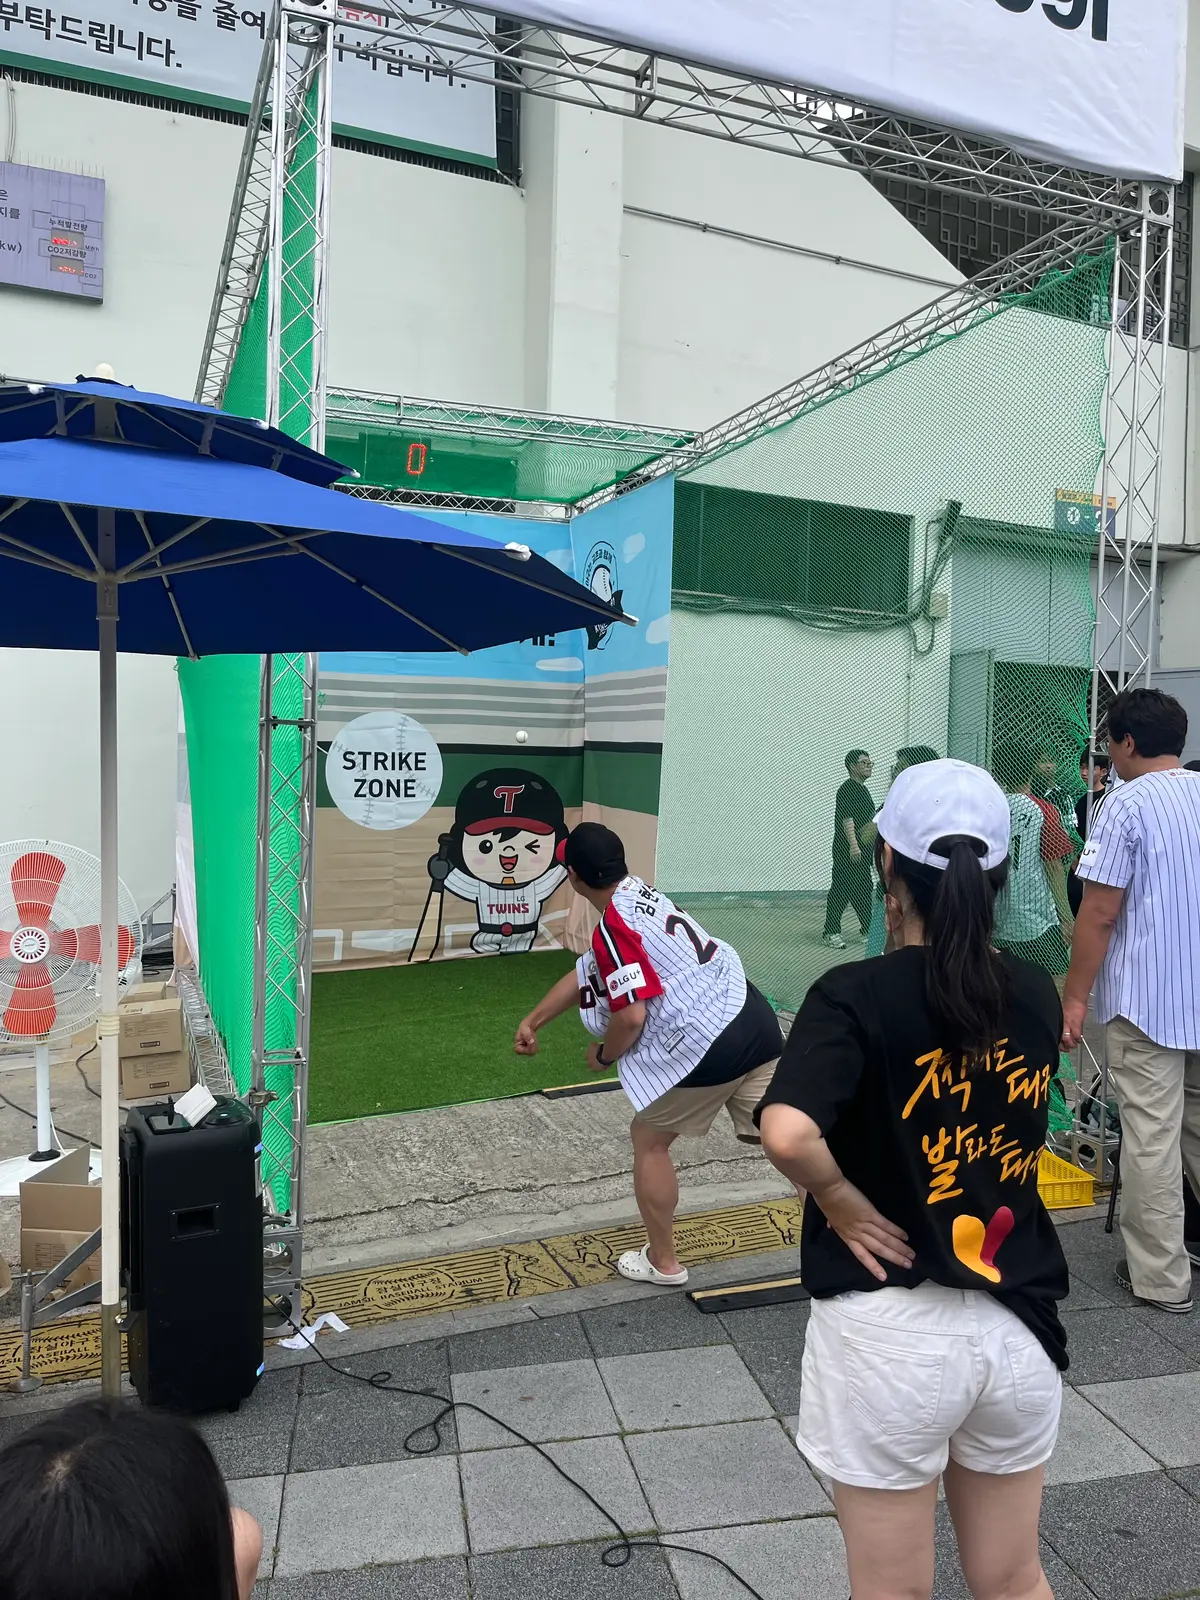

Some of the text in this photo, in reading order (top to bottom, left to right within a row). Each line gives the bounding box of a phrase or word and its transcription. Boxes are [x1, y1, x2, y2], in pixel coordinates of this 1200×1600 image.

[0, 1, 182, 68] 부탁드립니다.
[406, 443, 427, 475] 0
[342, 751, 427, 771] STRIKE
[354, 778, 416, 798] ZONE
[487, 903, 529, 914] TWINS
